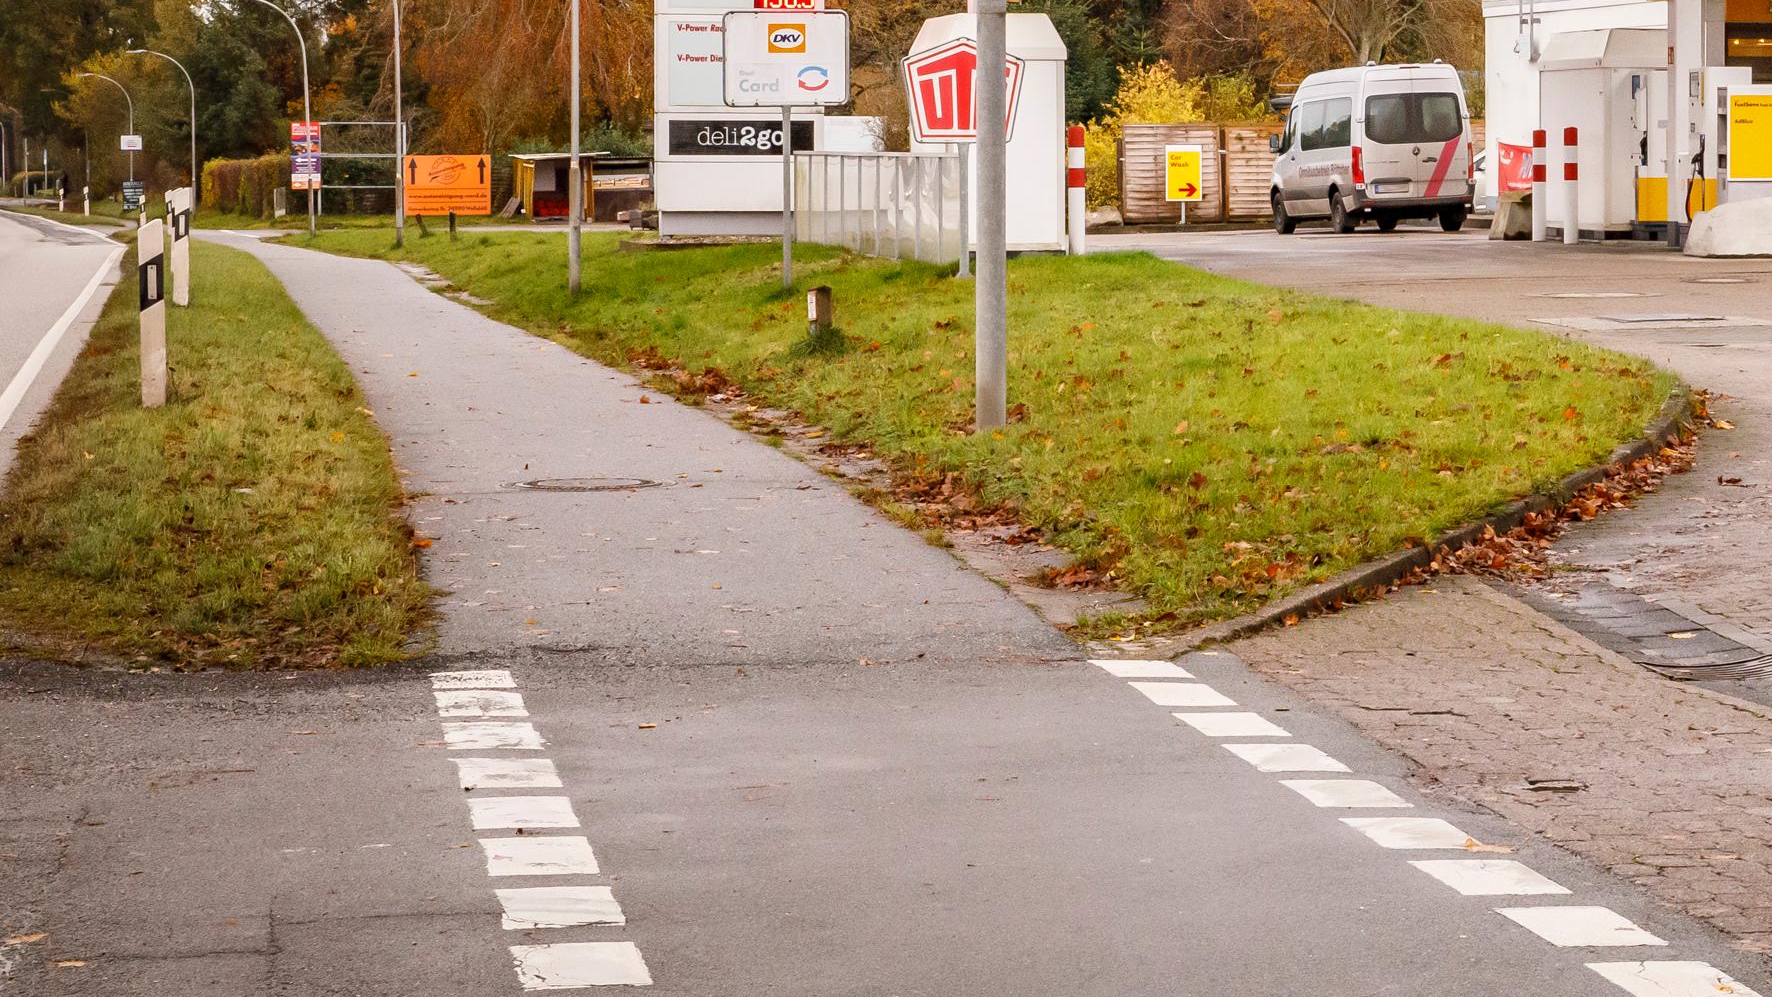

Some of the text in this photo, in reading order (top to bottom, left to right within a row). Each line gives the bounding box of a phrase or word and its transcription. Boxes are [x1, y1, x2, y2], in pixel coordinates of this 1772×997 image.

[677, 24, 708, 32] V-Power
[773, 34, 801, 43] DKV
[677, 54, 708, 63] V-Power
[738, 78, 780, 93] Card
[697, 126, 784, 150] deli2go
